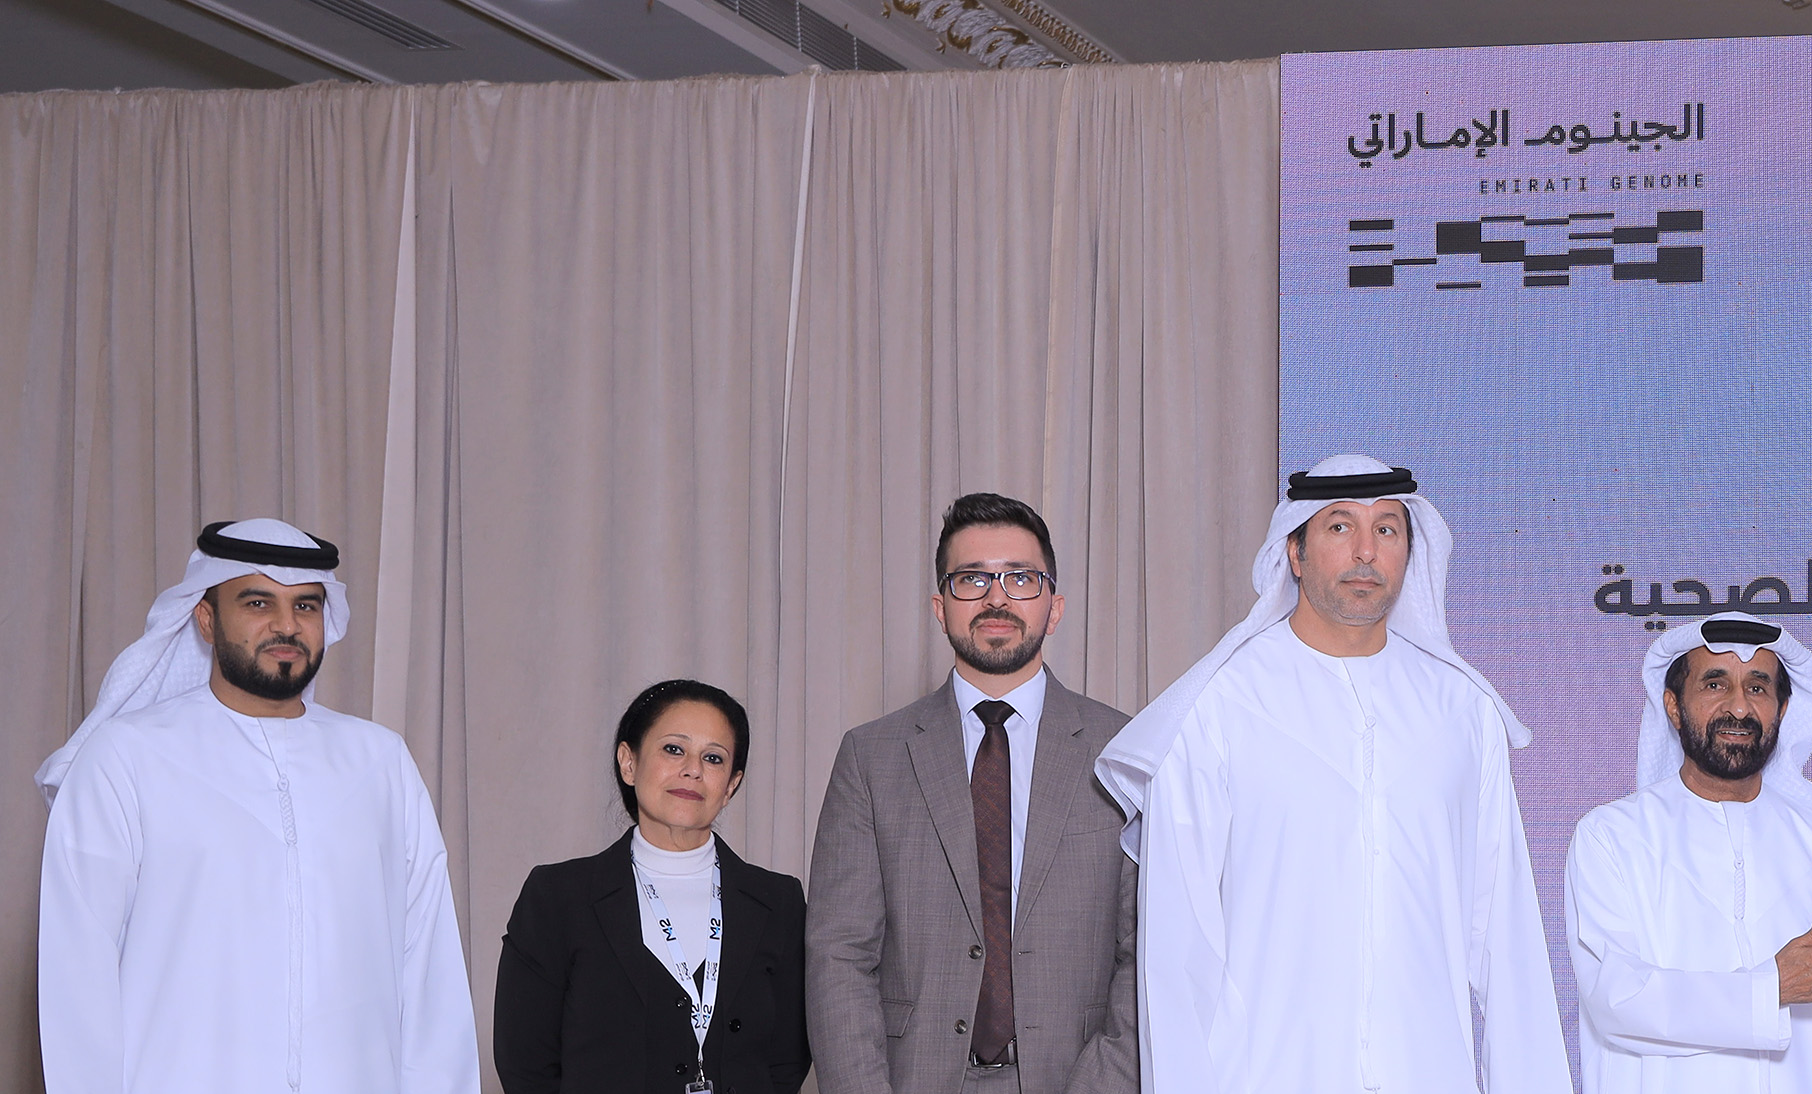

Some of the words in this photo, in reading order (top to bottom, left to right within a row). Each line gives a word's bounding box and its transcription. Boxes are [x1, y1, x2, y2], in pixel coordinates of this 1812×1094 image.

[1347, 109, 1509, 169] الإماراتي
[1480, 177, 1588, 195] EMIRATI
[1610, 173, 1705, 191] GENOME
